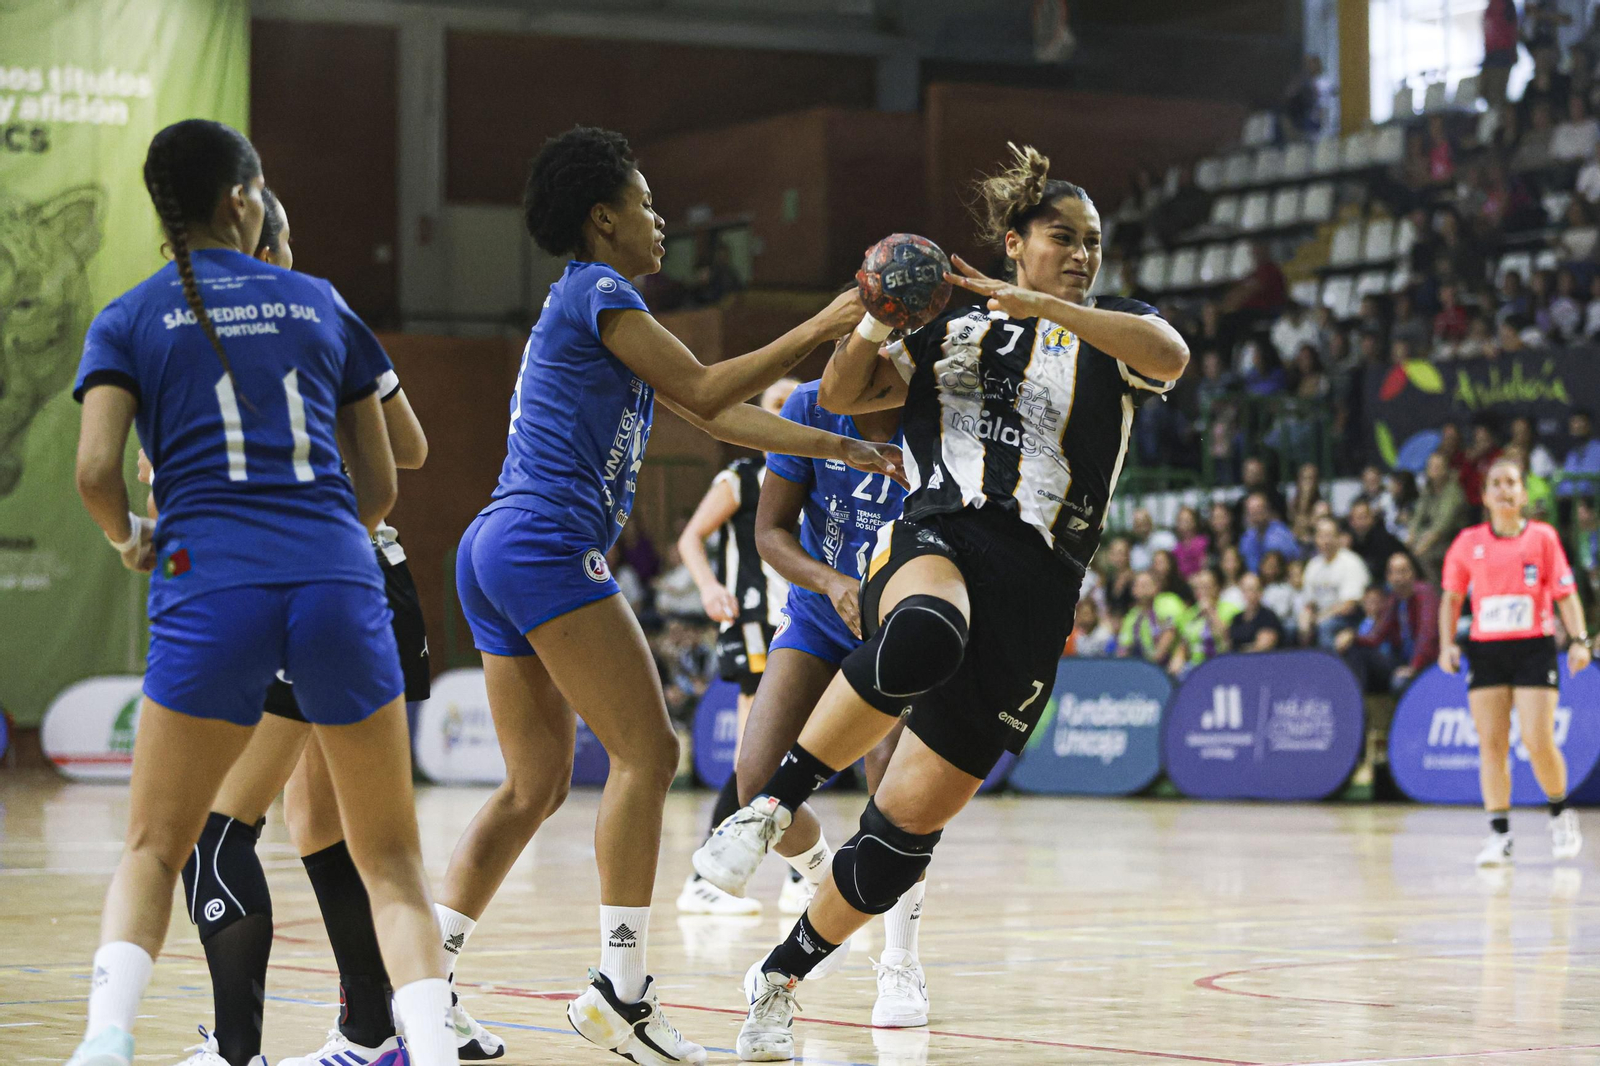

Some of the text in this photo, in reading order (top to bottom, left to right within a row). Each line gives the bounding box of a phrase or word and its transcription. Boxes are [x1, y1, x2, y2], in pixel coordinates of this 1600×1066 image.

[885, 264, 938, 289] SELECT
[261, 303, 287, 319] DO
[289, 303, 322, 323] SUL
[215, 322, 280, 338] PORTUGAL
[996, 323, 1025, 356] 7
[215, 368, 315, 482] 11
[857, 510, 881, 519] TERMAS
[1018, 679, 1044, 712] 7
